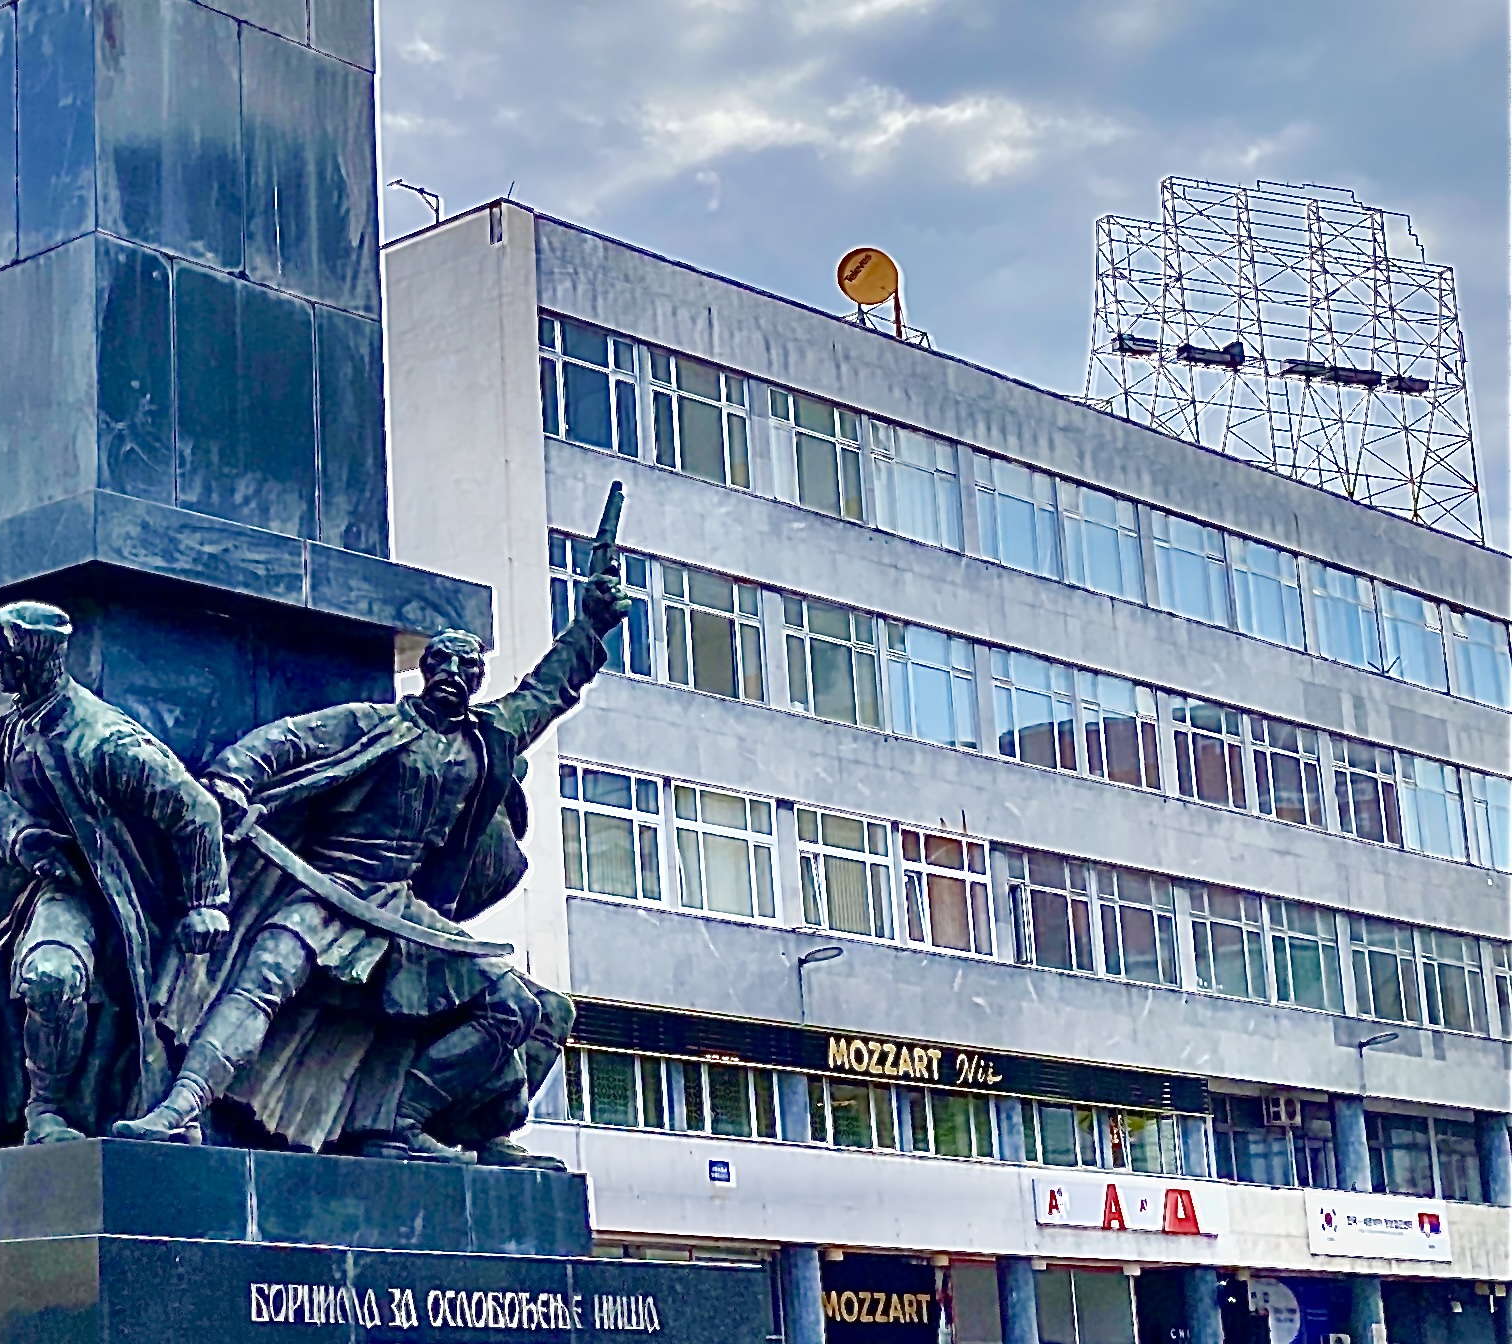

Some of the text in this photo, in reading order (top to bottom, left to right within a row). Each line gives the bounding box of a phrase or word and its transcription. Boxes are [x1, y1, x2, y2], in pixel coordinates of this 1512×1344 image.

[843, 253, 872, 283] Televes
[828, 1036, 942, 1081] MOZZART
[250, 1282, 661, 1334] БОРЦИМА ЗА ОСЛОБОЂЕЊЕ НИША
[822, 1290, 931, 1325] MOZZART
